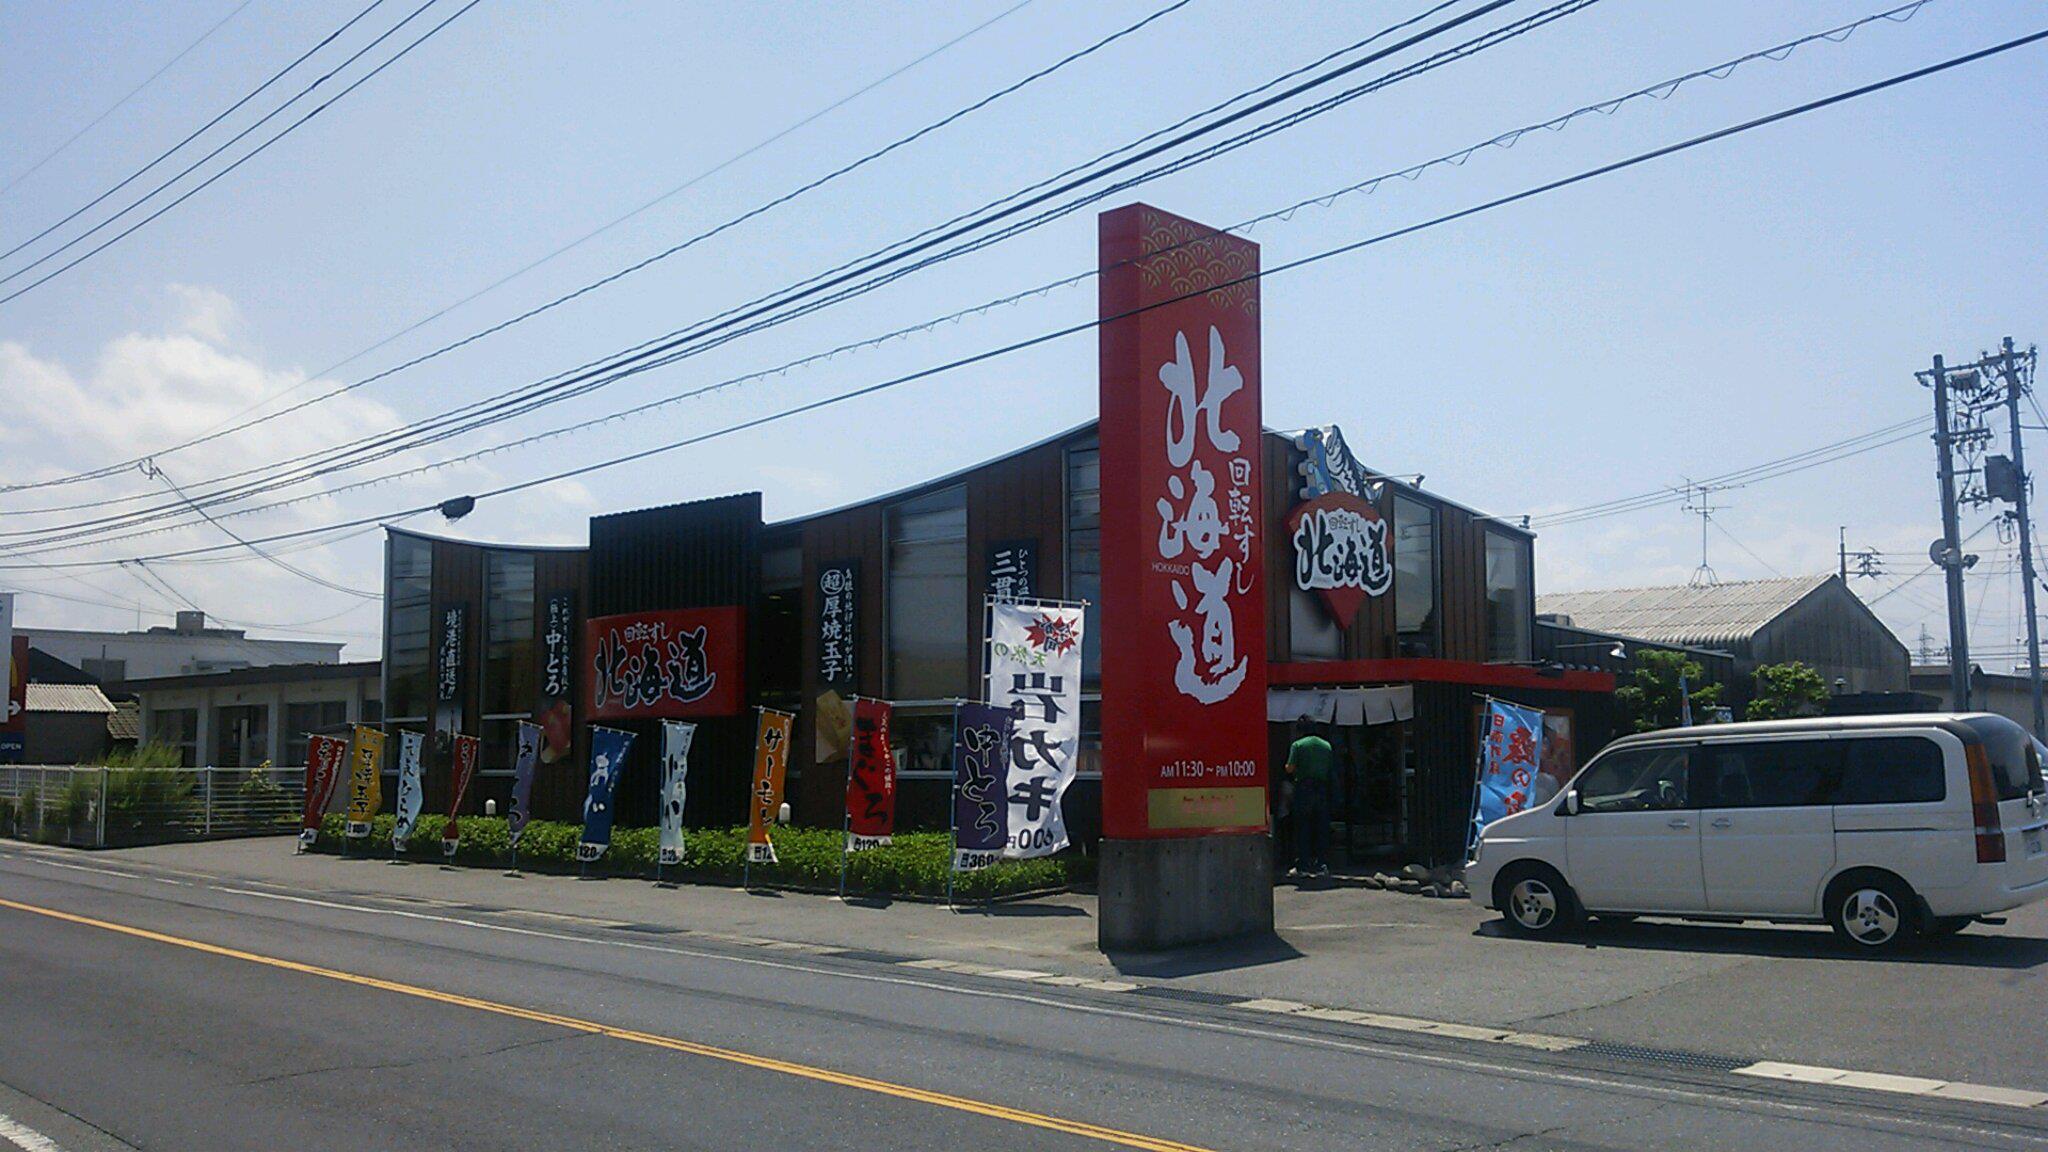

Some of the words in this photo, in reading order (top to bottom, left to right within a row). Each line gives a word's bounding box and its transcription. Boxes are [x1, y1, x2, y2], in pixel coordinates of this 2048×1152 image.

[1156, 325, 1249, 705] 北海道
[1228, 457, 1256, 595] 回転すし
[1296, 512, 1391, 592] 北海道
[1151, 561, 1190, 577] HOKKAIDO
[593, 624, 717, 709] 北海道
[0, 743, 22, 751] OPEN
[755, 726, 784, 827] サーモン
[1160, 760, 1204, 778] AM11:30
[1215, 760, 1256, 777] PM10:00
